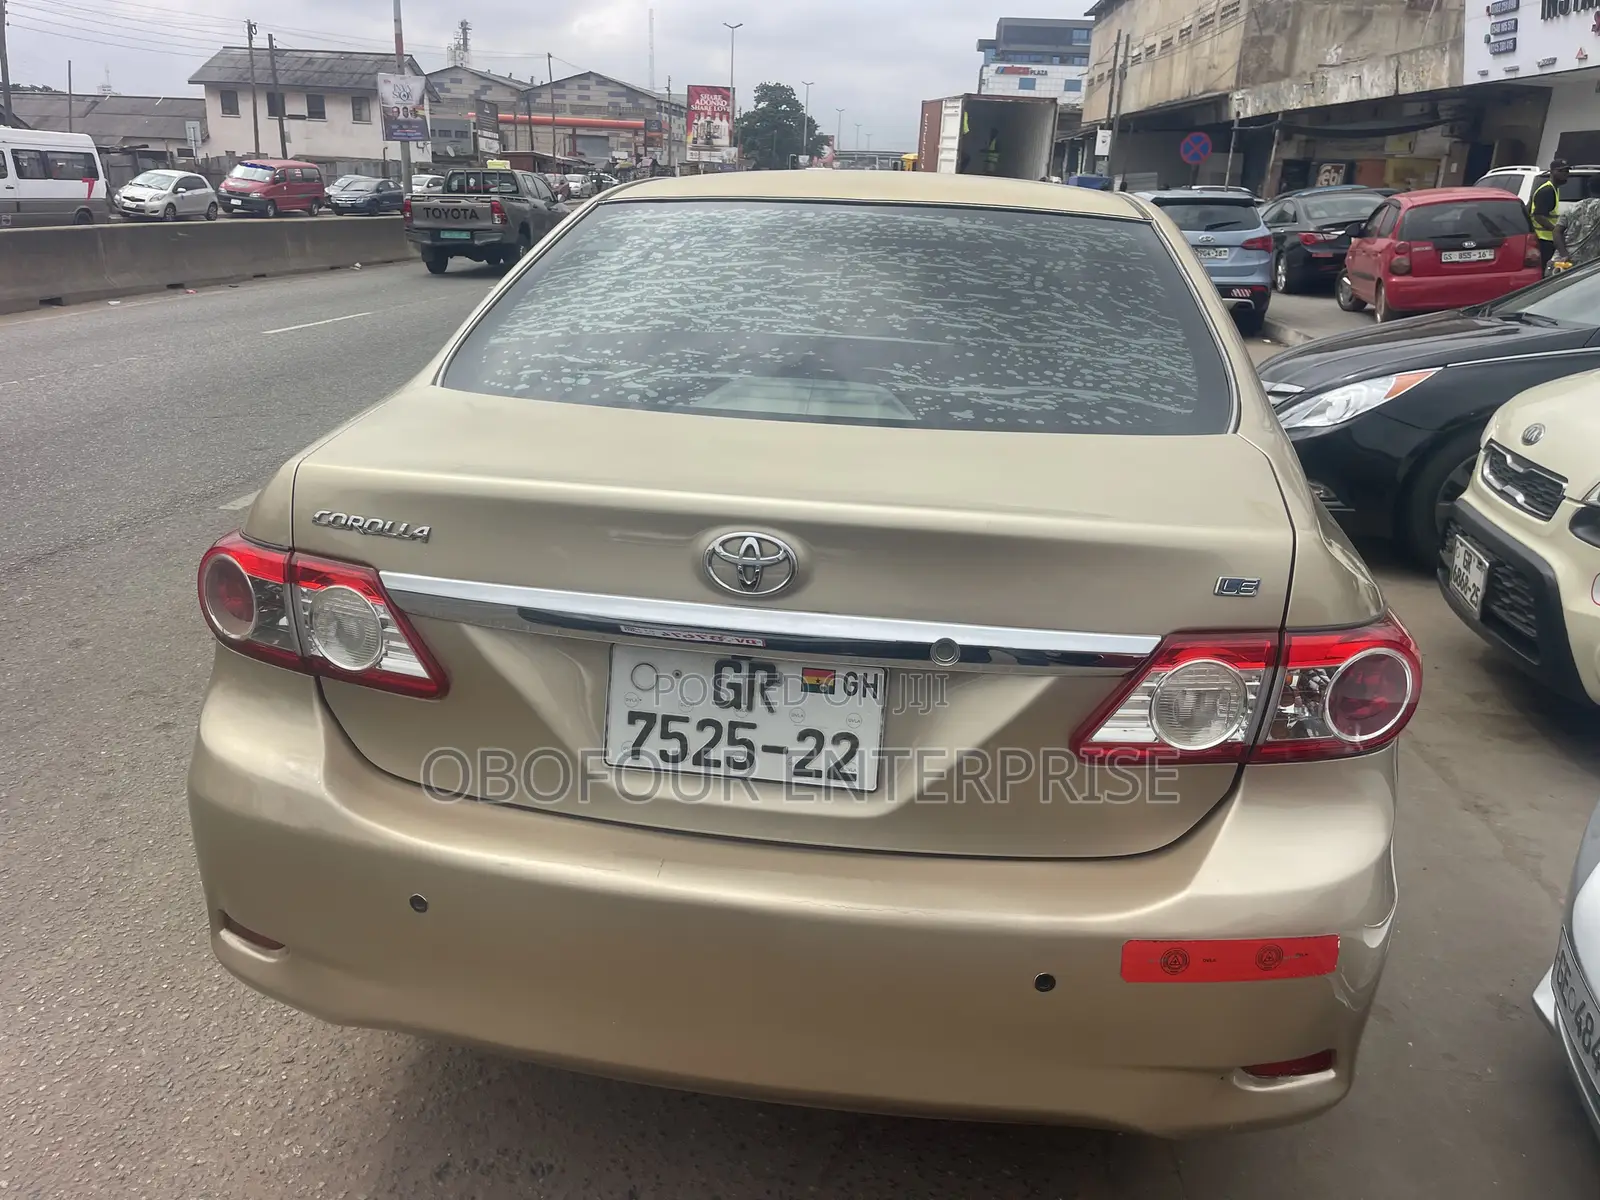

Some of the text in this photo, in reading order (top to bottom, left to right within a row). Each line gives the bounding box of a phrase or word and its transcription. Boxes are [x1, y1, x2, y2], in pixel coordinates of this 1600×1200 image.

[700, 93, 722, 101] SHARE
[423, 207, 479, 219] TOYOTA
[312, 510, 431, 544] COROLLA
[1214, 576, 1261, 598] LE
[713, 660, 777, 713] GR
[842, 670, 879, 699] GH
[627, 710, 860, 782] 7525-22
